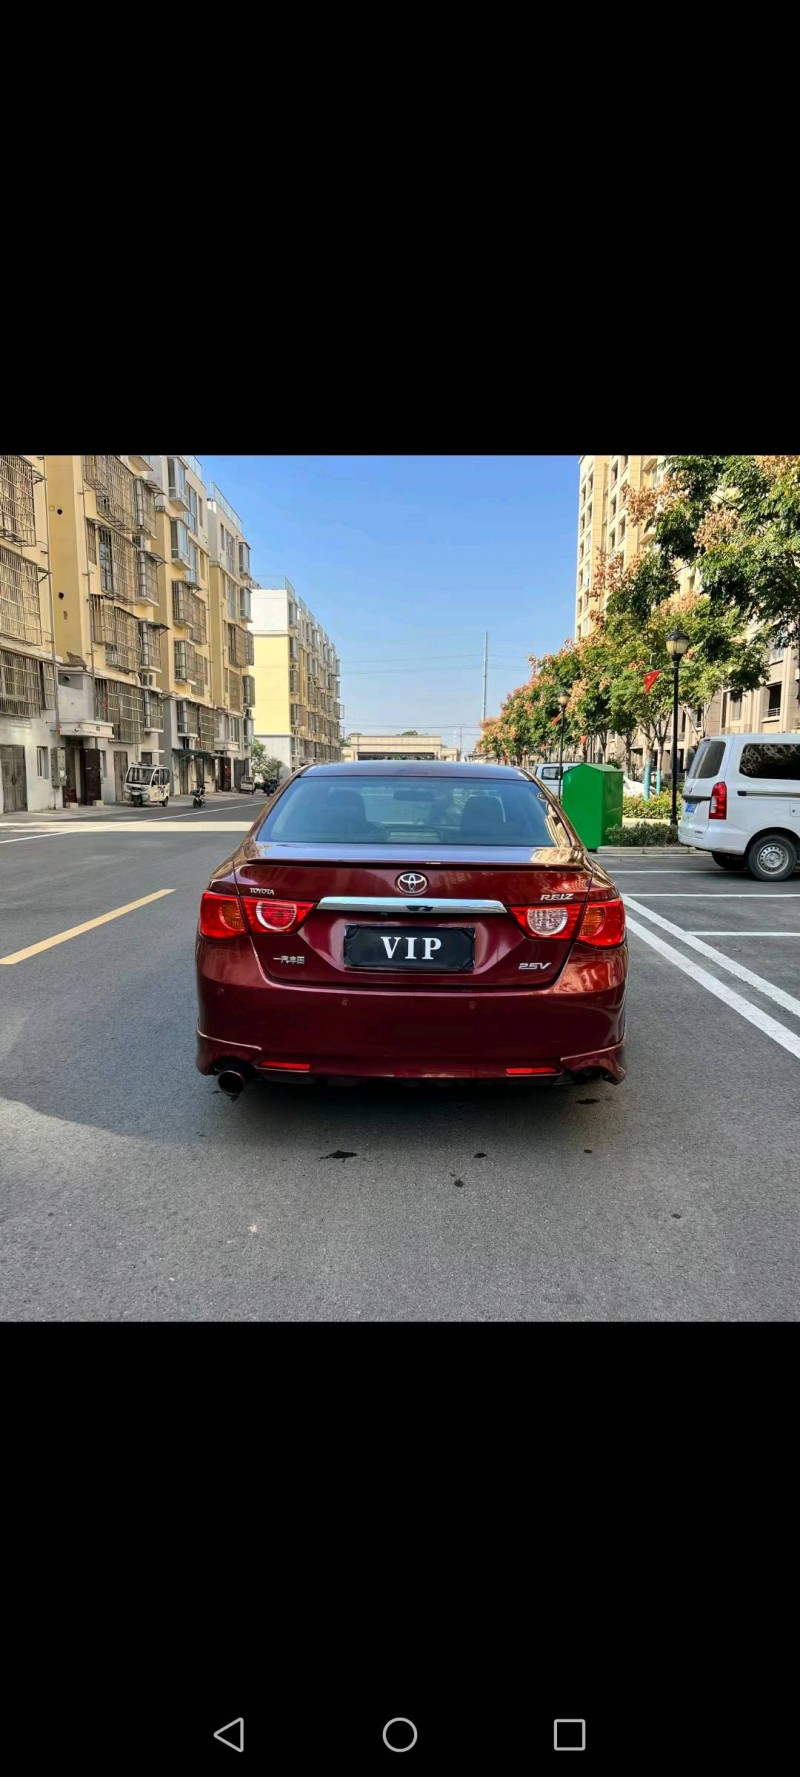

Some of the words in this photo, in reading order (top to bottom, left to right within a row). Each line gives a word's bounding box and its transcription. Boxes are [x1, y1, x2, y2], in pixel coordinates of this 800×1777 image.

[249, 887, 275, 896] TOYOTA
[540, 893, 574, 901] REIZ
[380, 936, 442, 960] VIP
